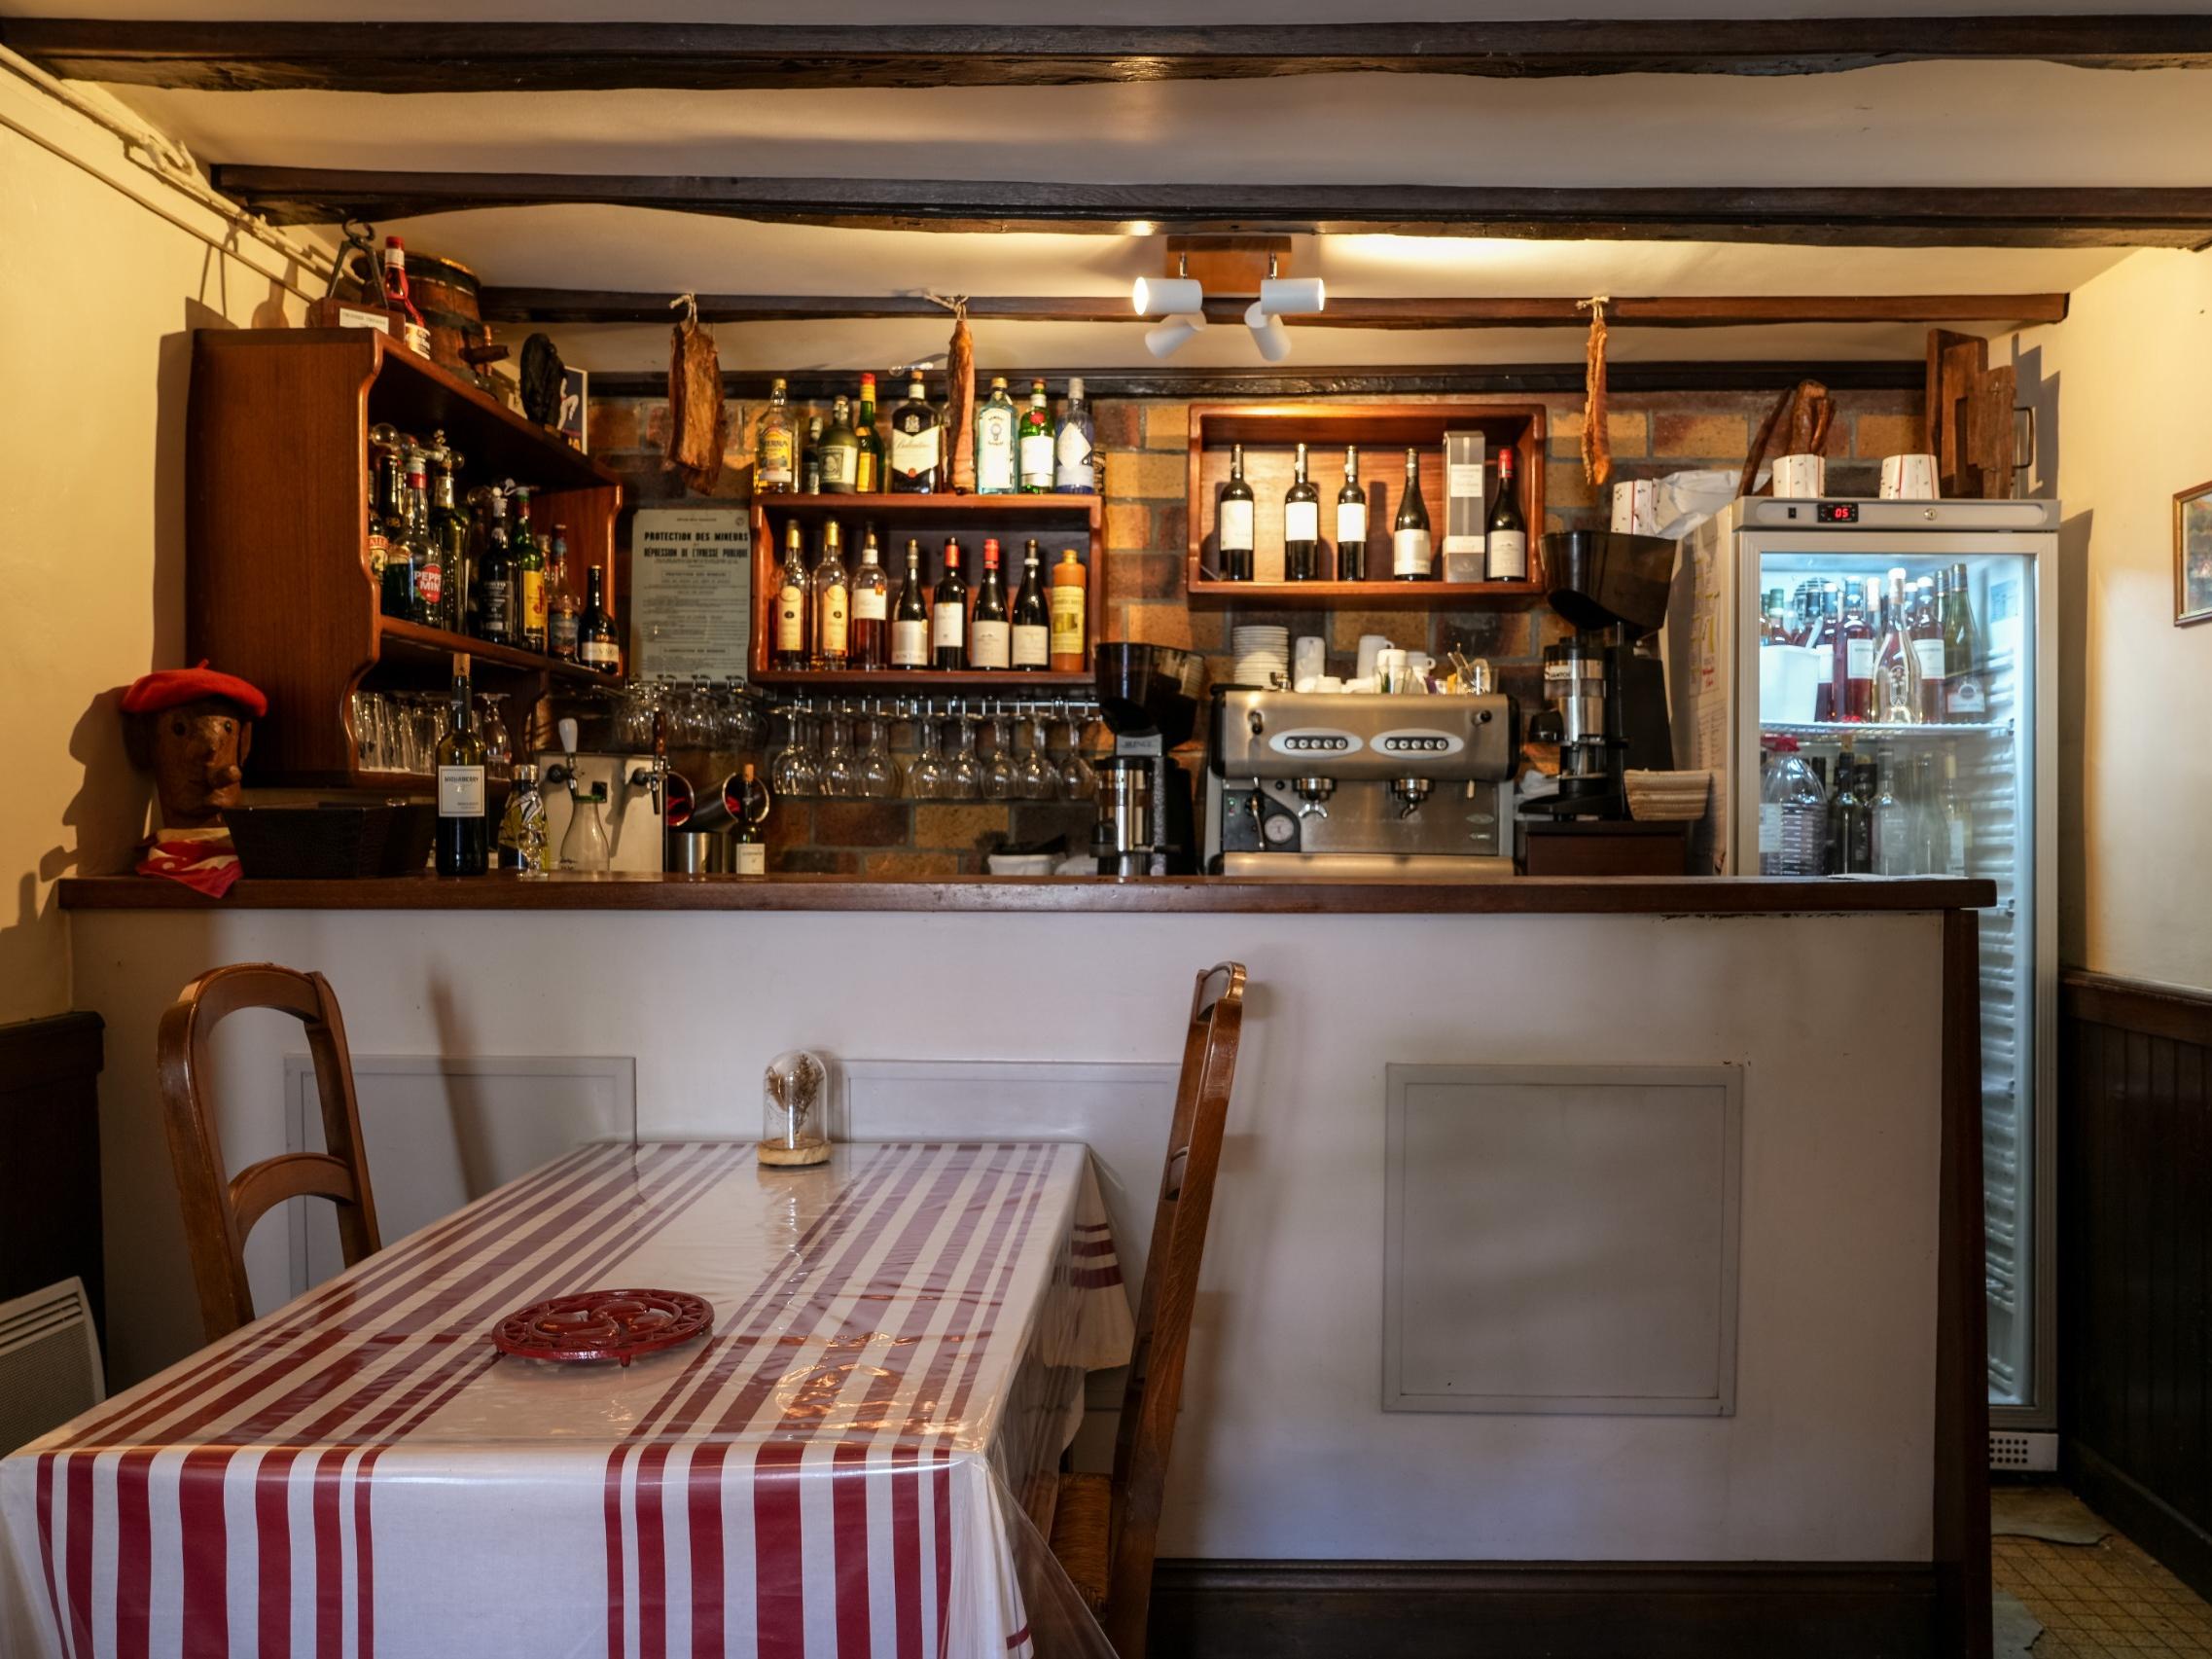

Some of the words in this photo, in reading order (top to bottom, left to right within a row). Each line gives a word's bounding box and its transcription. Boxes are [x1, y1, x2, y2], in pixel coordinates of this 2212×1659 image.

[644, 531, 692, 541] PROTECTION
[696, 531, 710, 541] DES
[714, 531, 749, 541] MINEURS
